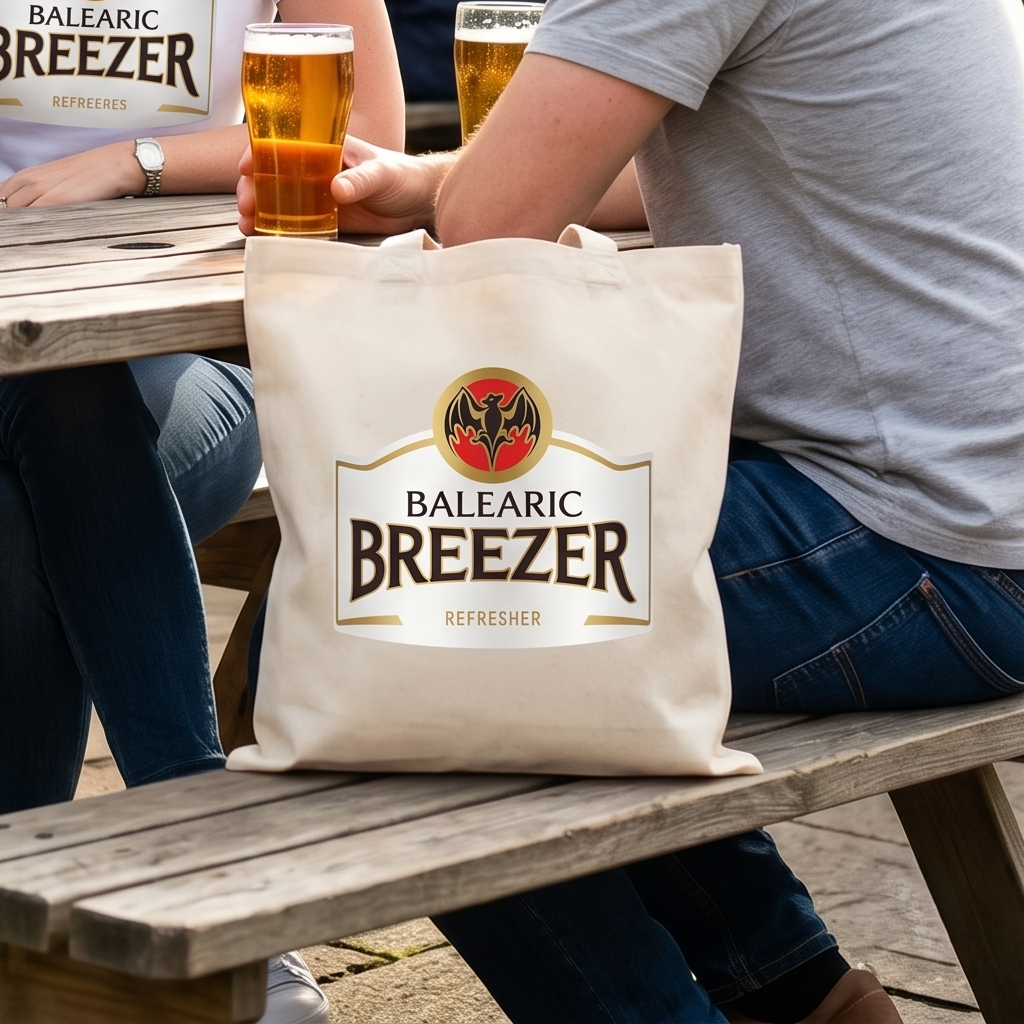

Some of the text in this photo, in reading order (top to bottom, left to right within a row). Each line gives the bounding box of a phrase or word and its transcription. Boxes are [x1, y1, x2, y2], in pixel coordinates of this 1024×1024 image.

[29, 4, 159, 30] BALEARIC
[52, 95, 127, 111] REFREERES
[406, 490, 582, 518] BALEARIC
[349, 517, 637, 604] BREEZER
[445, 611, 541, 626] REFRESHER
